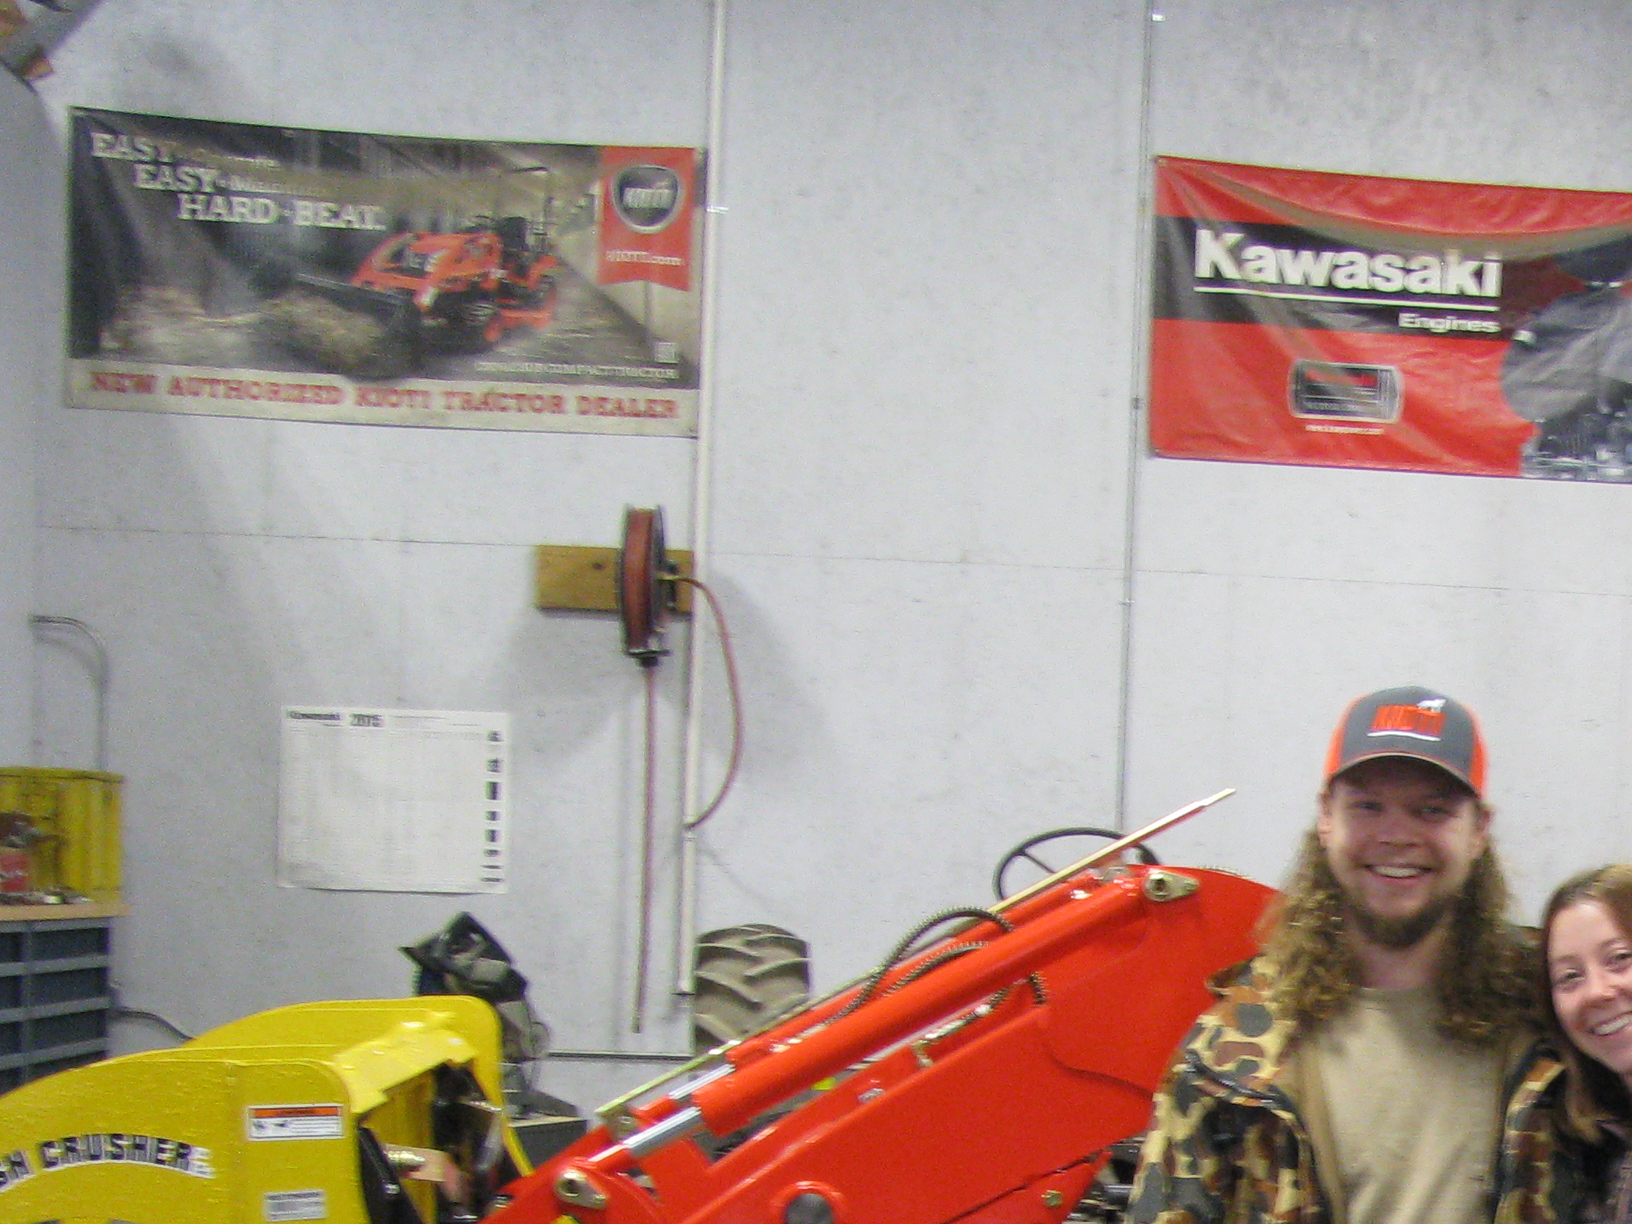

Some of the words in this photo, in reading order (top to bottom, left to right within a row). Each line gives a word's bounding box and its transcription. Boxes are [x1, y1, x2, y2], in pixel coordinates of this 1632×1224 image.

[177, 193, 279, 224] HARD
[1194, 229, 1502, 298] Kawasaki
[1399, 313, 1502, 333] Engines
[91, 371, 157, 394] NEW
[169, 375, 343, 405] AUTHORIZED
[354, 385, 430, 410] KIOTI
[442, 390, 569, 415] TRACTOR
[576, 395, 680, 419] DEALER
[41, 1133, 216, 1179] CRUSHER
